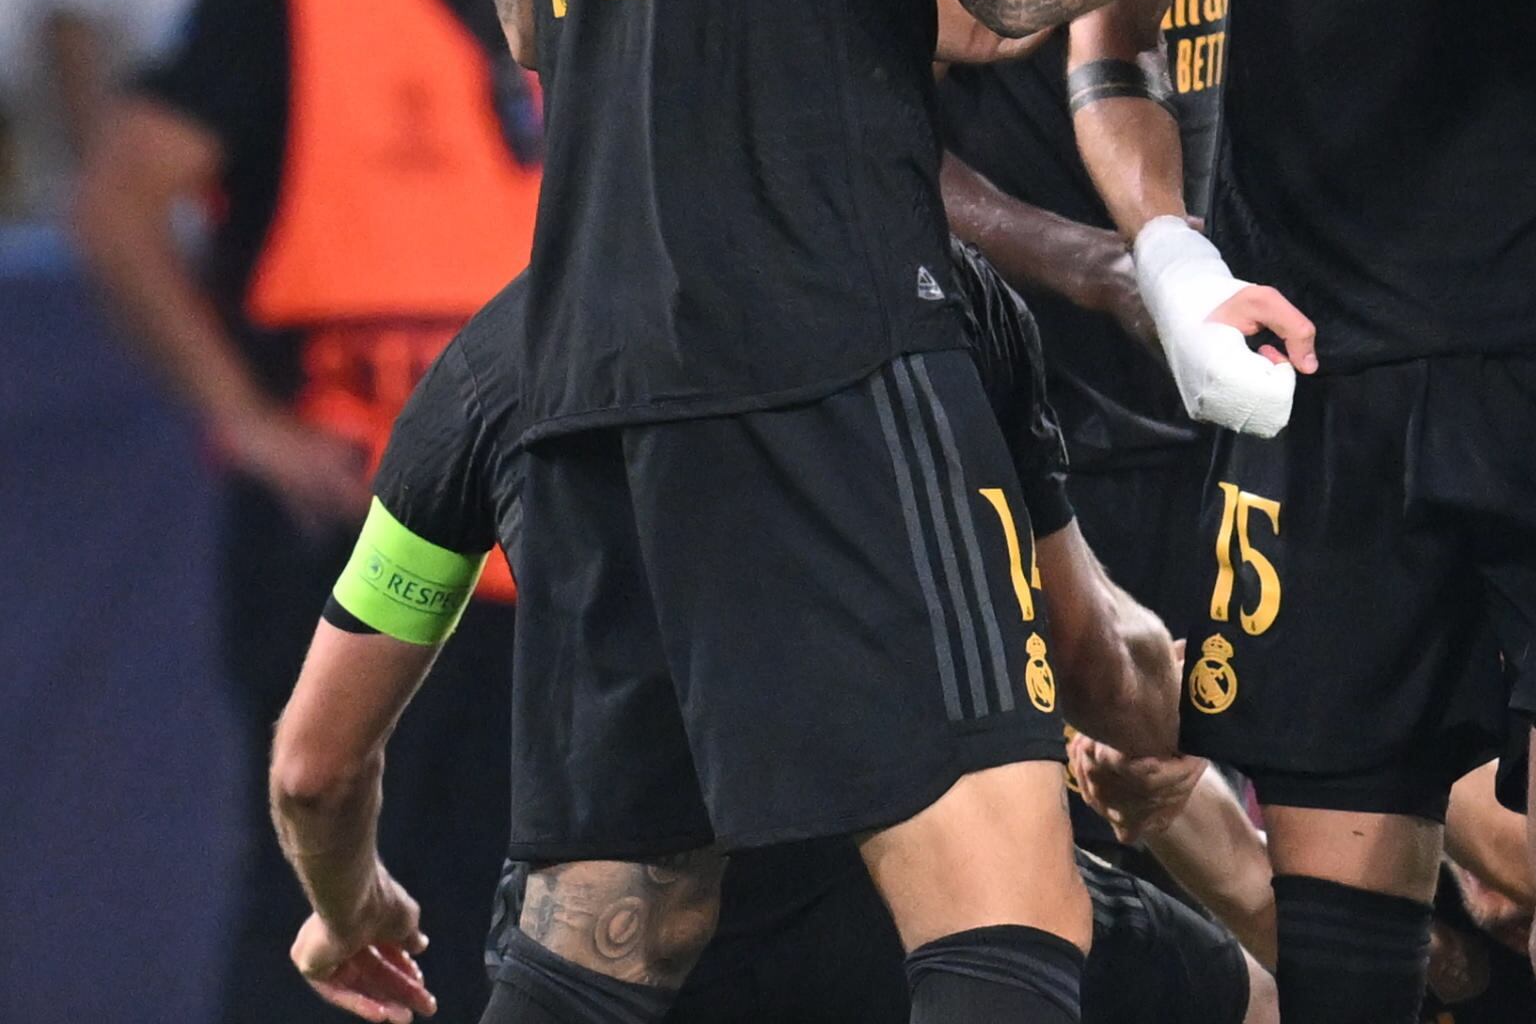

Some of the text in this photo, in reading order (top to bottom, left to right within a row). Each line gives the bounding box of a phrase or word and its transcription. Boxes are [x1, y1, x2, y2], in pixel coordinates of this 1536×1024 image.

[387, 572, 460, 610] RESPE
[977, 487, 1043, 622] 1
[1209, 480, 1282, 637] 15
